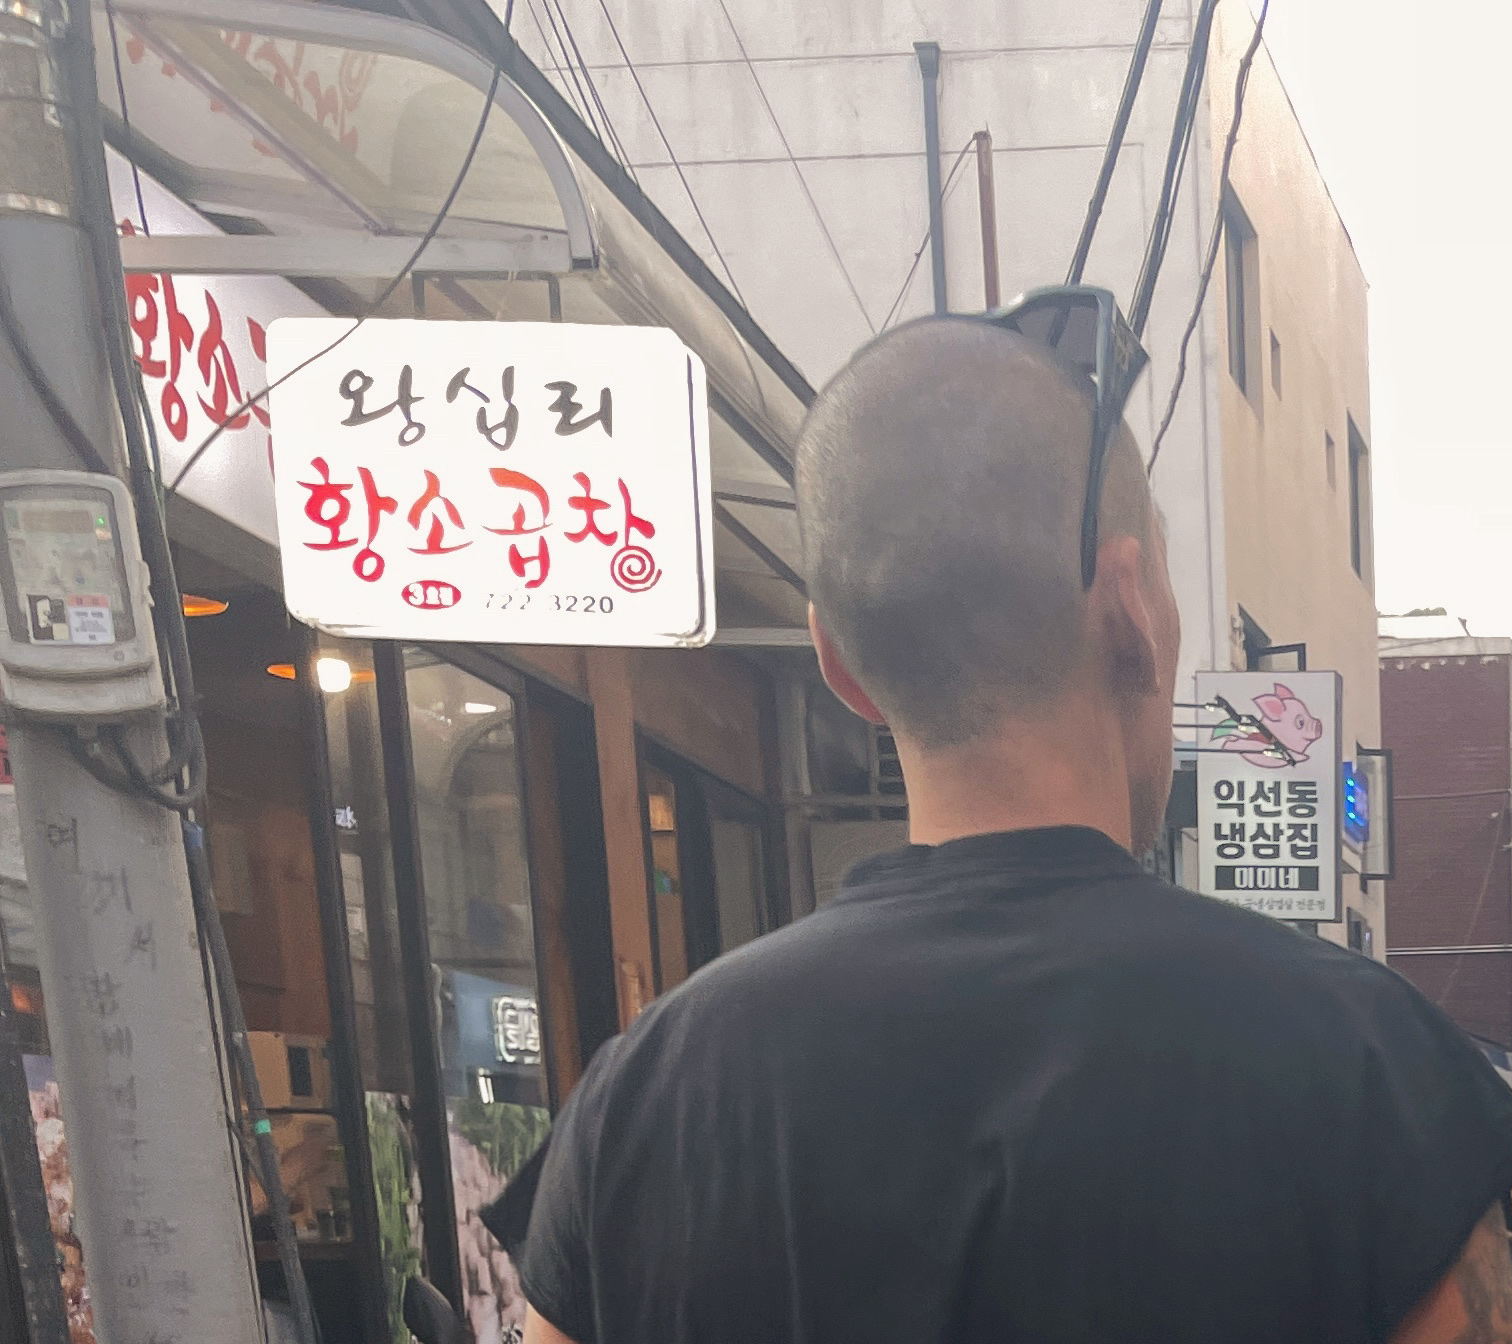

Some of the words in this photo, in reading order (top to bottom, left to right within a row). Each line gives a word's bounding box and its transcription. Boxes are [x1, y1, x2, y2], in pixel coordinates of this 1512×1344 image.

[338, 364, 613, 451] 왕십리
[296, 456, 662, 594] 황소곱창
[1214, 779, 1319, 818] 익선동
[1214, 822, 1318, 860] 냉삼집
